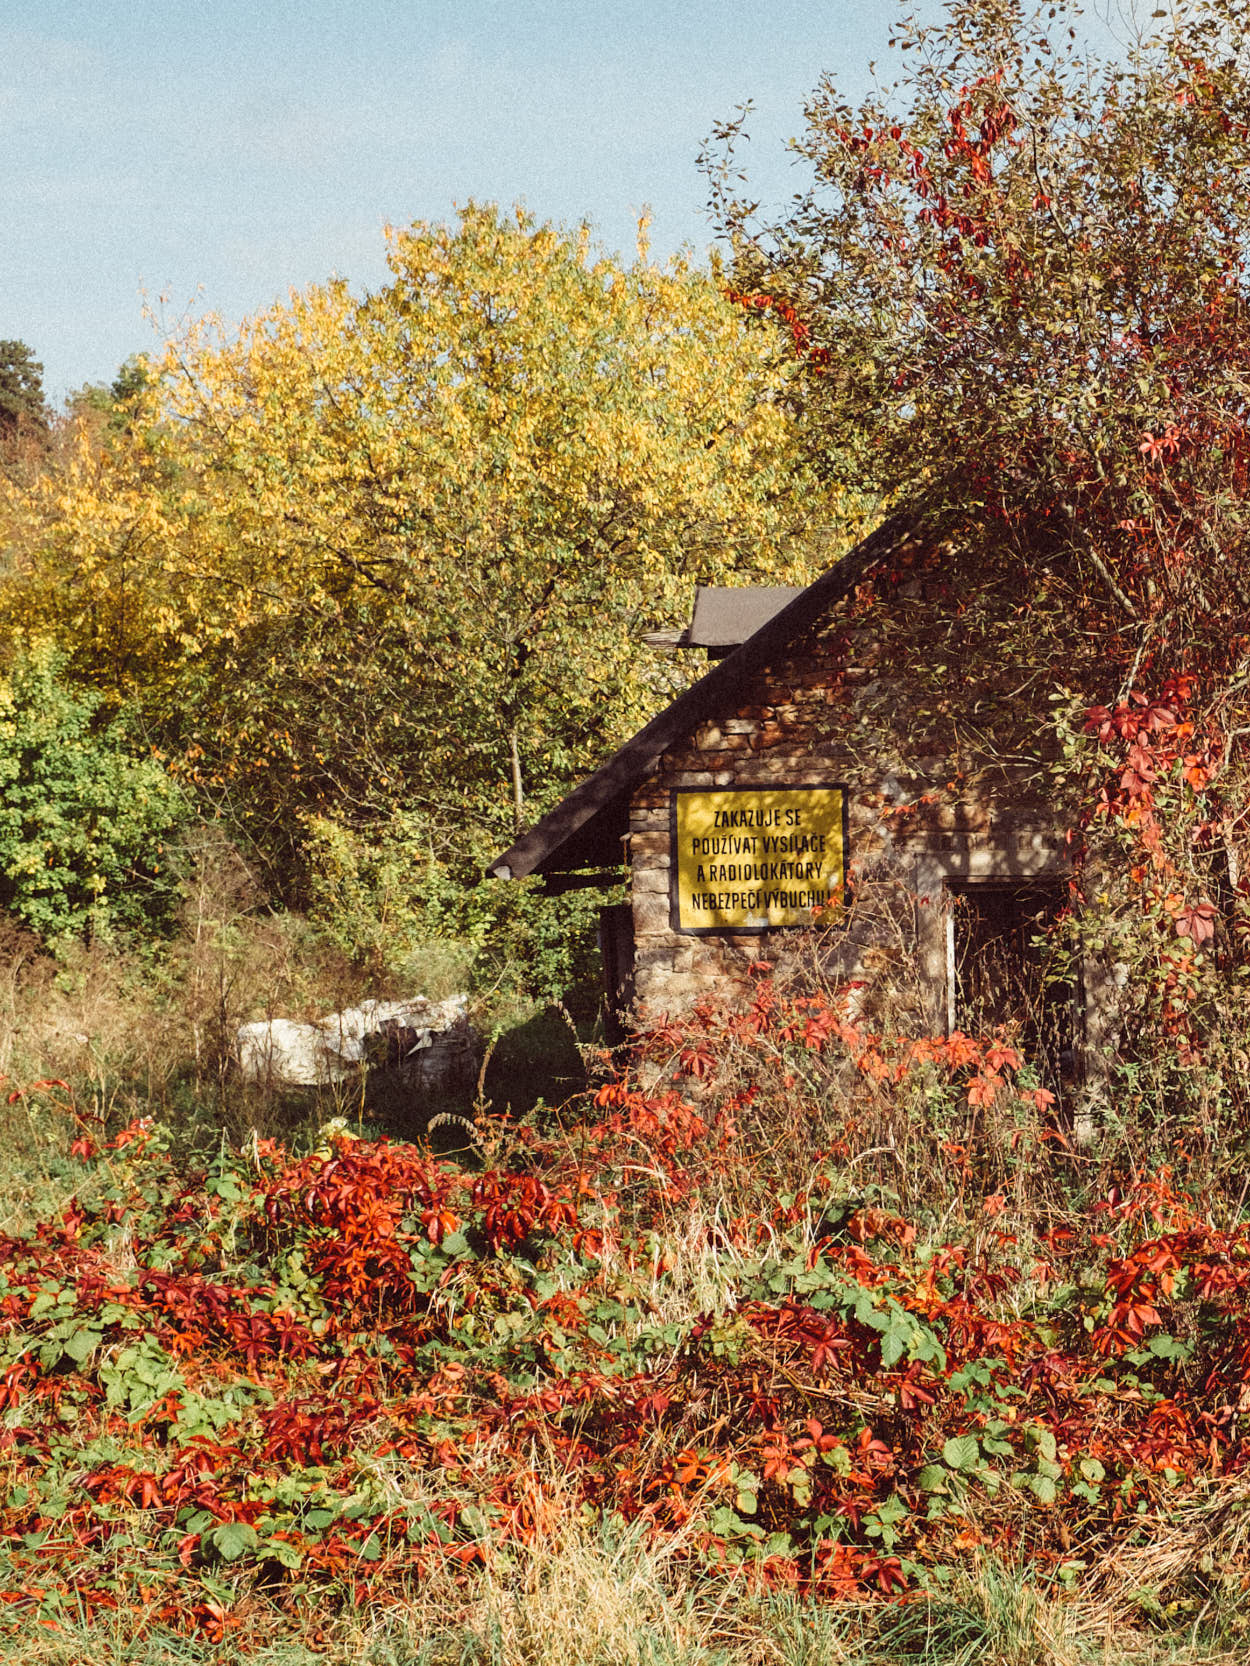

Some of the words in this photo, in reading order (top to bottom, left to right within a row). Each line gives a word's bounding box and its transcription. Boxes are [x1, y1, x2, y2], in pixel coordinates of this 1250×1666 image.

[714, 809, 781, 828] ZAKAZUJE
[786, 809, 801, 826] SE
[692, 835, 758, 855] POUŽÍVAT
[763, 832, 826, 853] VYSÍLAČE
[697, 865, 706, 882] A
[710, 860, 823, 881] RADIOLOKÁTORY
[692, 889, 760, 910] NEBEZPEČÍ
